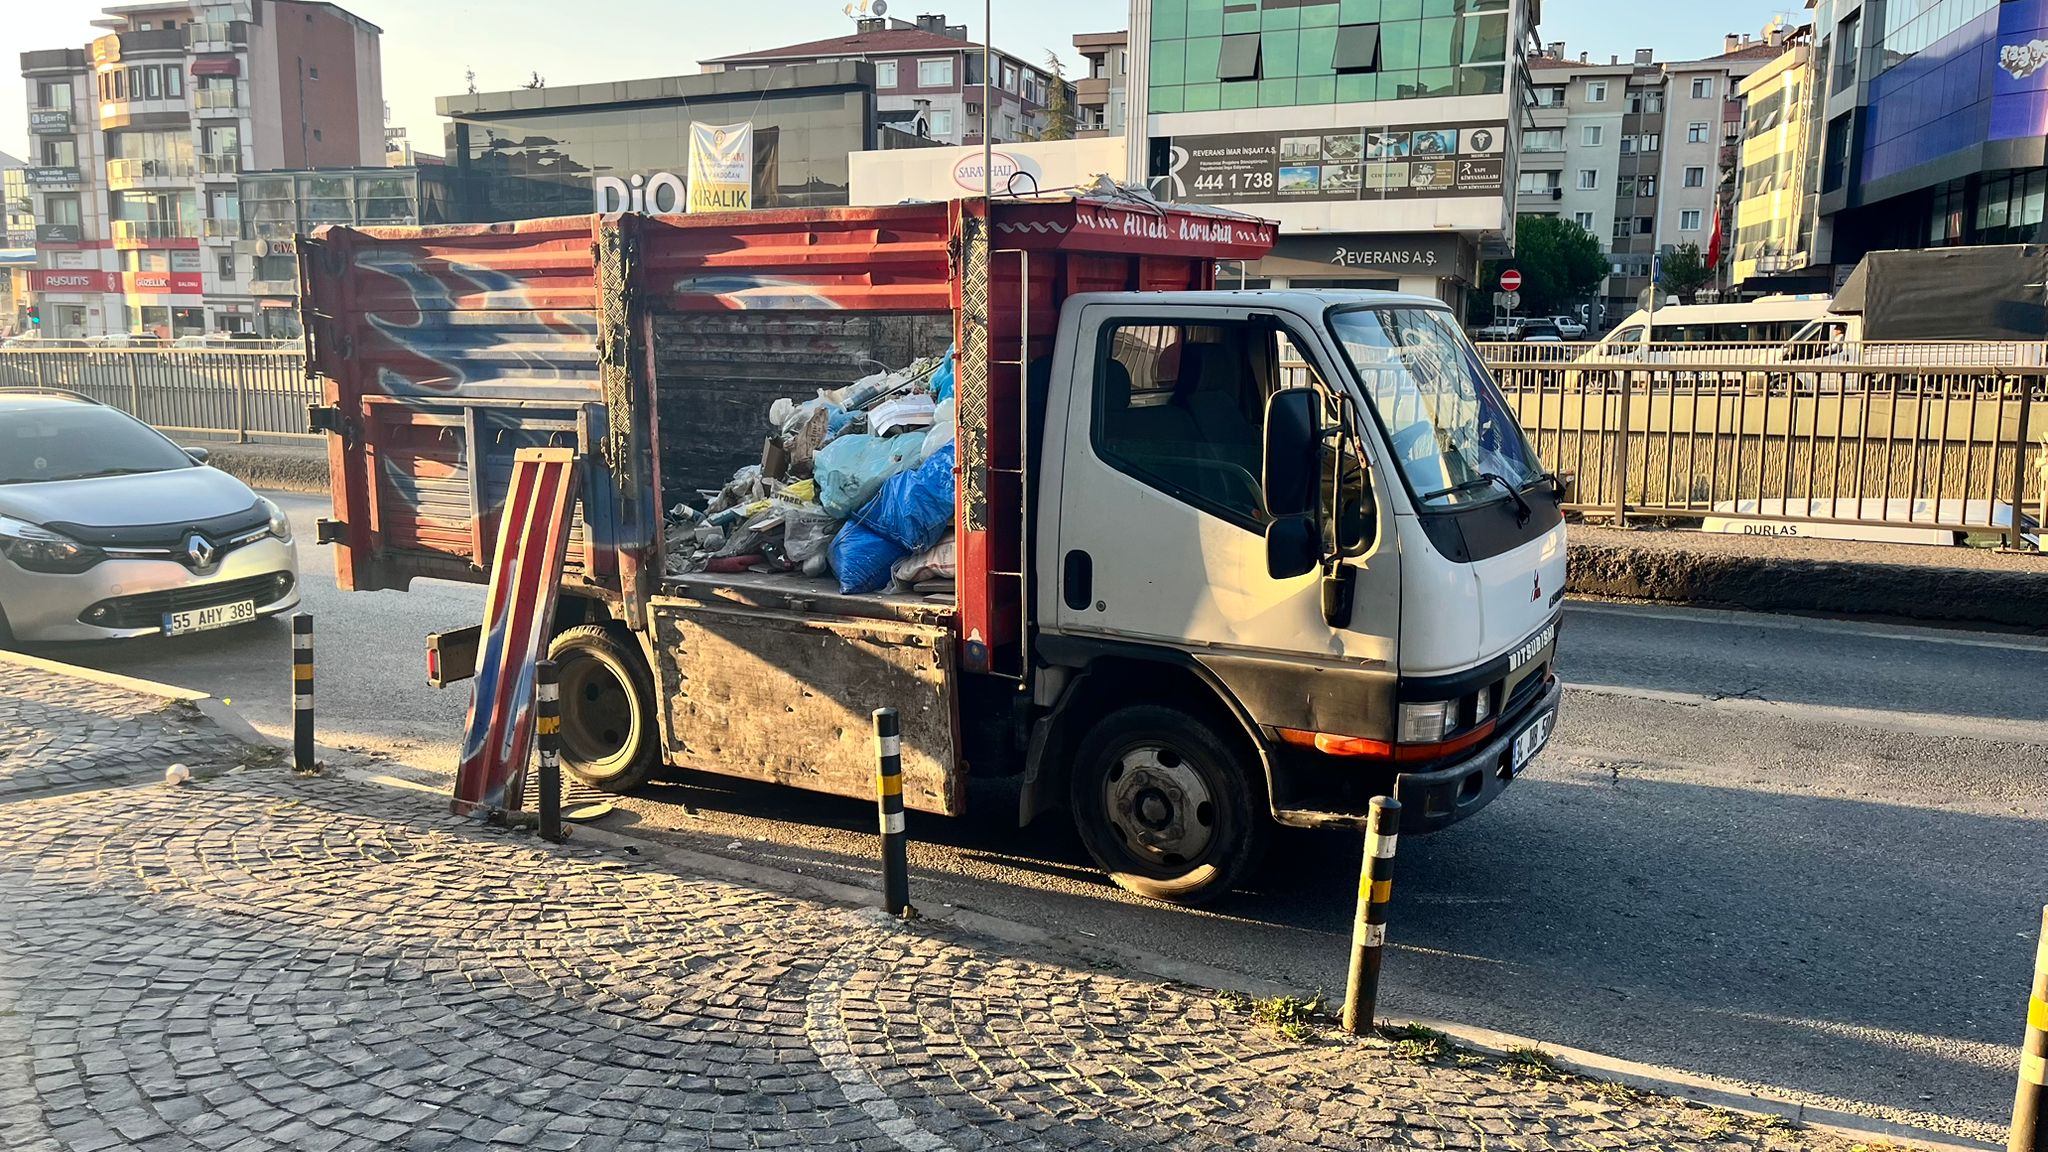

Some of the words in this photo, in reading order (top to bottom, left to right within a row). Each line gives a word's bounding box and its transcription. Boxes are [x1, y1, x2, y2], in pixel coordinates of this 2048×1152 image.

[1192, 148, 1225, 157] REVERANS
[1242, 146, 1264, 156] İNŞAAT
[991, 165, 1011, 177] HALI
[1194, 174, 1223, 190] 444
[1229, 174, 1237, 189] 1
[1243, 172, 1273, 189] 738
[694, 190, 747, 208] KIRALIK
[1123, 213, 1168, 239] Allah
[1179, 218, 1233, 244] Korusun
[1412, 250, 1438, 267] A.Ş.
[1743, 524, 1798, 537] DURLAS
[173, 614, 190, 629] 55
[199, 608, 223, 625] AHY
[230, 602, 253, 619] 389
[1510, 625, 1554, 672] MITSUBISHI
